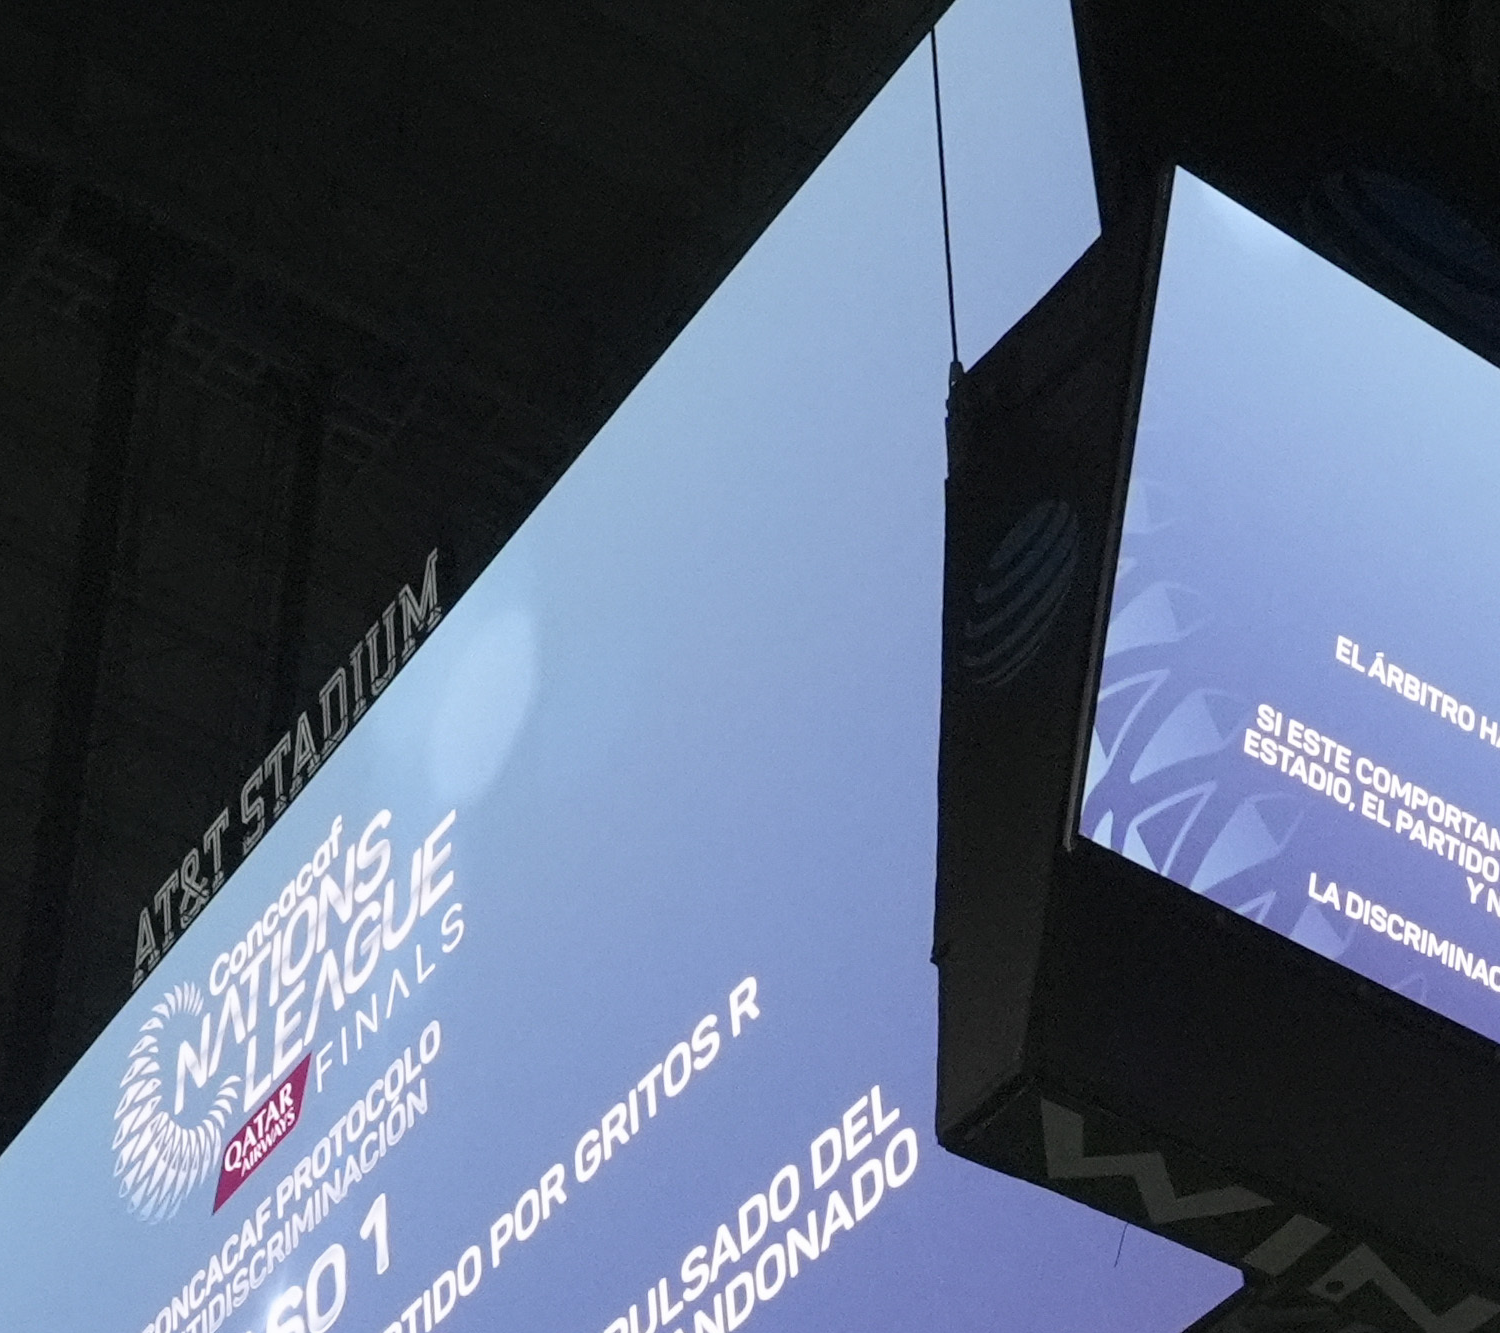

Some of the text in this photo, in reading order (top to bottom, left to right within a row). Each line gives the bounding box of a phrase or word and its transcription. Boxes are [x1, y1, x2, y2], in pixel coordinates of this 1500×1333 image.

[1256, 703, 1283, 737] SI
[1287, 718, 1352, 775] ESTE
[1335, 635, 1366, 673] EL
[1367, 651, 1476, 732] ÁRBITRO
[132, 547, 442, 991] AT&T STADIUM
[1243, 728, 1356, 812] ESTADIO,
[1361, 790, 1391, 828] EL
[1395, 808, 1500, 883] PARTIDO
[210, 816, 342, 992] Concacaf
[1308, 872, 1341, 911] LA
[1466, 876, 1485, 905] Y
[174, 809, 392, 1114] NATIONS
[243, 810, 458, 1114] LEAGUE
[316, 903, 466, 1094] FINALS
[223, 1082, 295, 1177] QATAR
[240, 1109, 297, 1179] AIRWAYS
[276, 1020, 441, 1220] PROTOCOLO
[490, 1163, 567, 1269] POR
[574, 1014, 721, 1183] GRITOS
[729, 976, 761, 1037] R
[810, 1093, 900, 1190] DEL
[359, 1193, 389, 1275] 1
